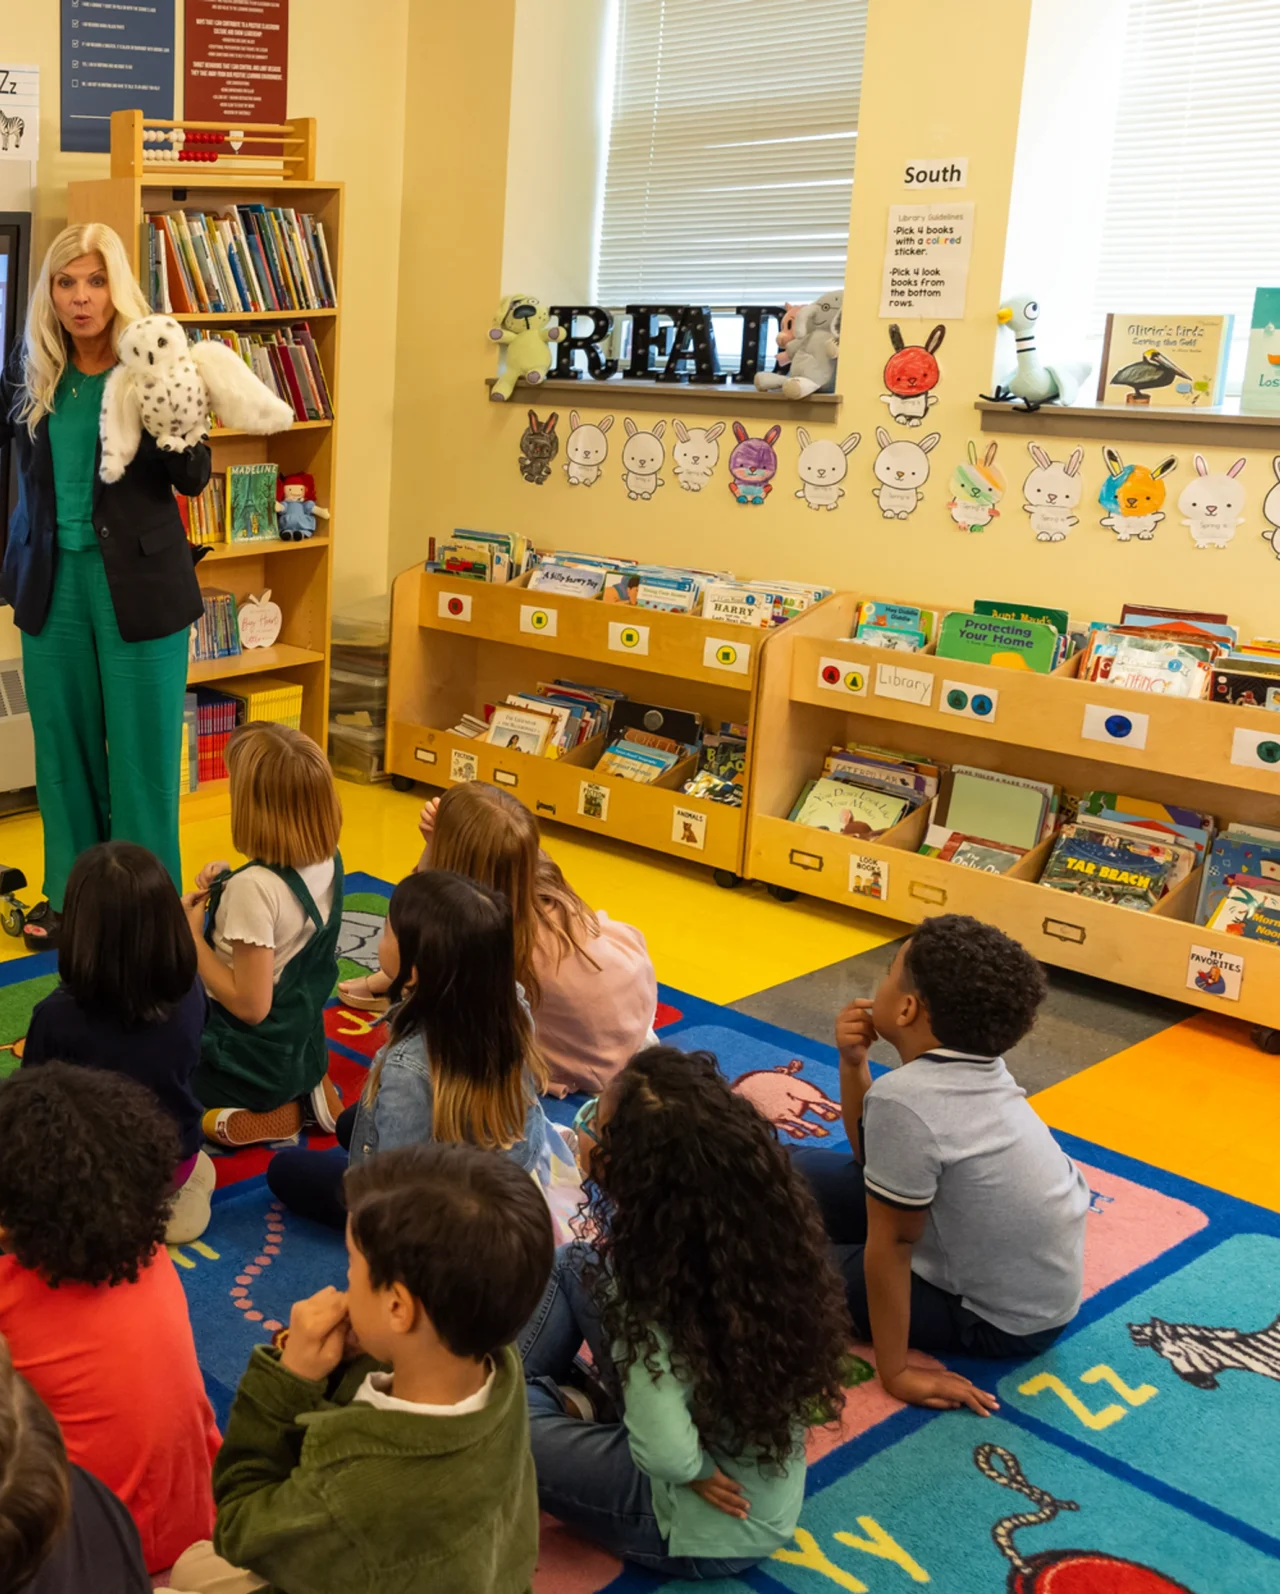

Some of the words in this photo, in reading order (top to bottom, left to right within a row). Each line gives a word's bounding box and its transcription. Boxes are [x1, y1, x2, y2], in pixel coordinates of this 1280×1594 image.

[904, 164, 962, 184] South
[898, 214, 926, 222] Library
[927, 213, 964, 221] Guidelines
[893, 226, 915, 235] -Pick
[917, 226, 924, 234] 4
[926, 225, 954, 235] books
[895, 237, 915, 245] with
[917, 237, 924, 245] a
[894, 247, 928, 256] sticker.
[889, 267, 911, 276] -Pick
[913, 267, 920, 276] 4
[921, 267, 941, 276] look
[890, 278, 918, 287] books
[920, 277, 945, 287] from
[890, 288, 905, 297] the
[907, 288, 942, 297] bottom
[889, 299, 915, 307] rows.
[1176, 326, 1205, 338] Birds
[231, 465, 278, 475] MADELINE
[713, 603, 754, 617] HARRY
[991, 608, 1016, 620] Aunt
[964, 618, 1033, 638] Protecting
[958, 628, 989, 643] Your
[992, 632, 1034, 649] Home
[880, 665, 931, 701] Library
[453, 751, 475, 762] FICTION
[583, 788, 606, 797] FICTION
[676, 809, 704, 822] ANIMALS
[1065, 857, 1097, 876] TAR
[1098, 865, 1152, 889] BEACH
[1210, 950, 1224, 960] MY
[1190, 953, 1242, 974] FAVORITES
[1019, 1363, 1158, 1430] Zz
